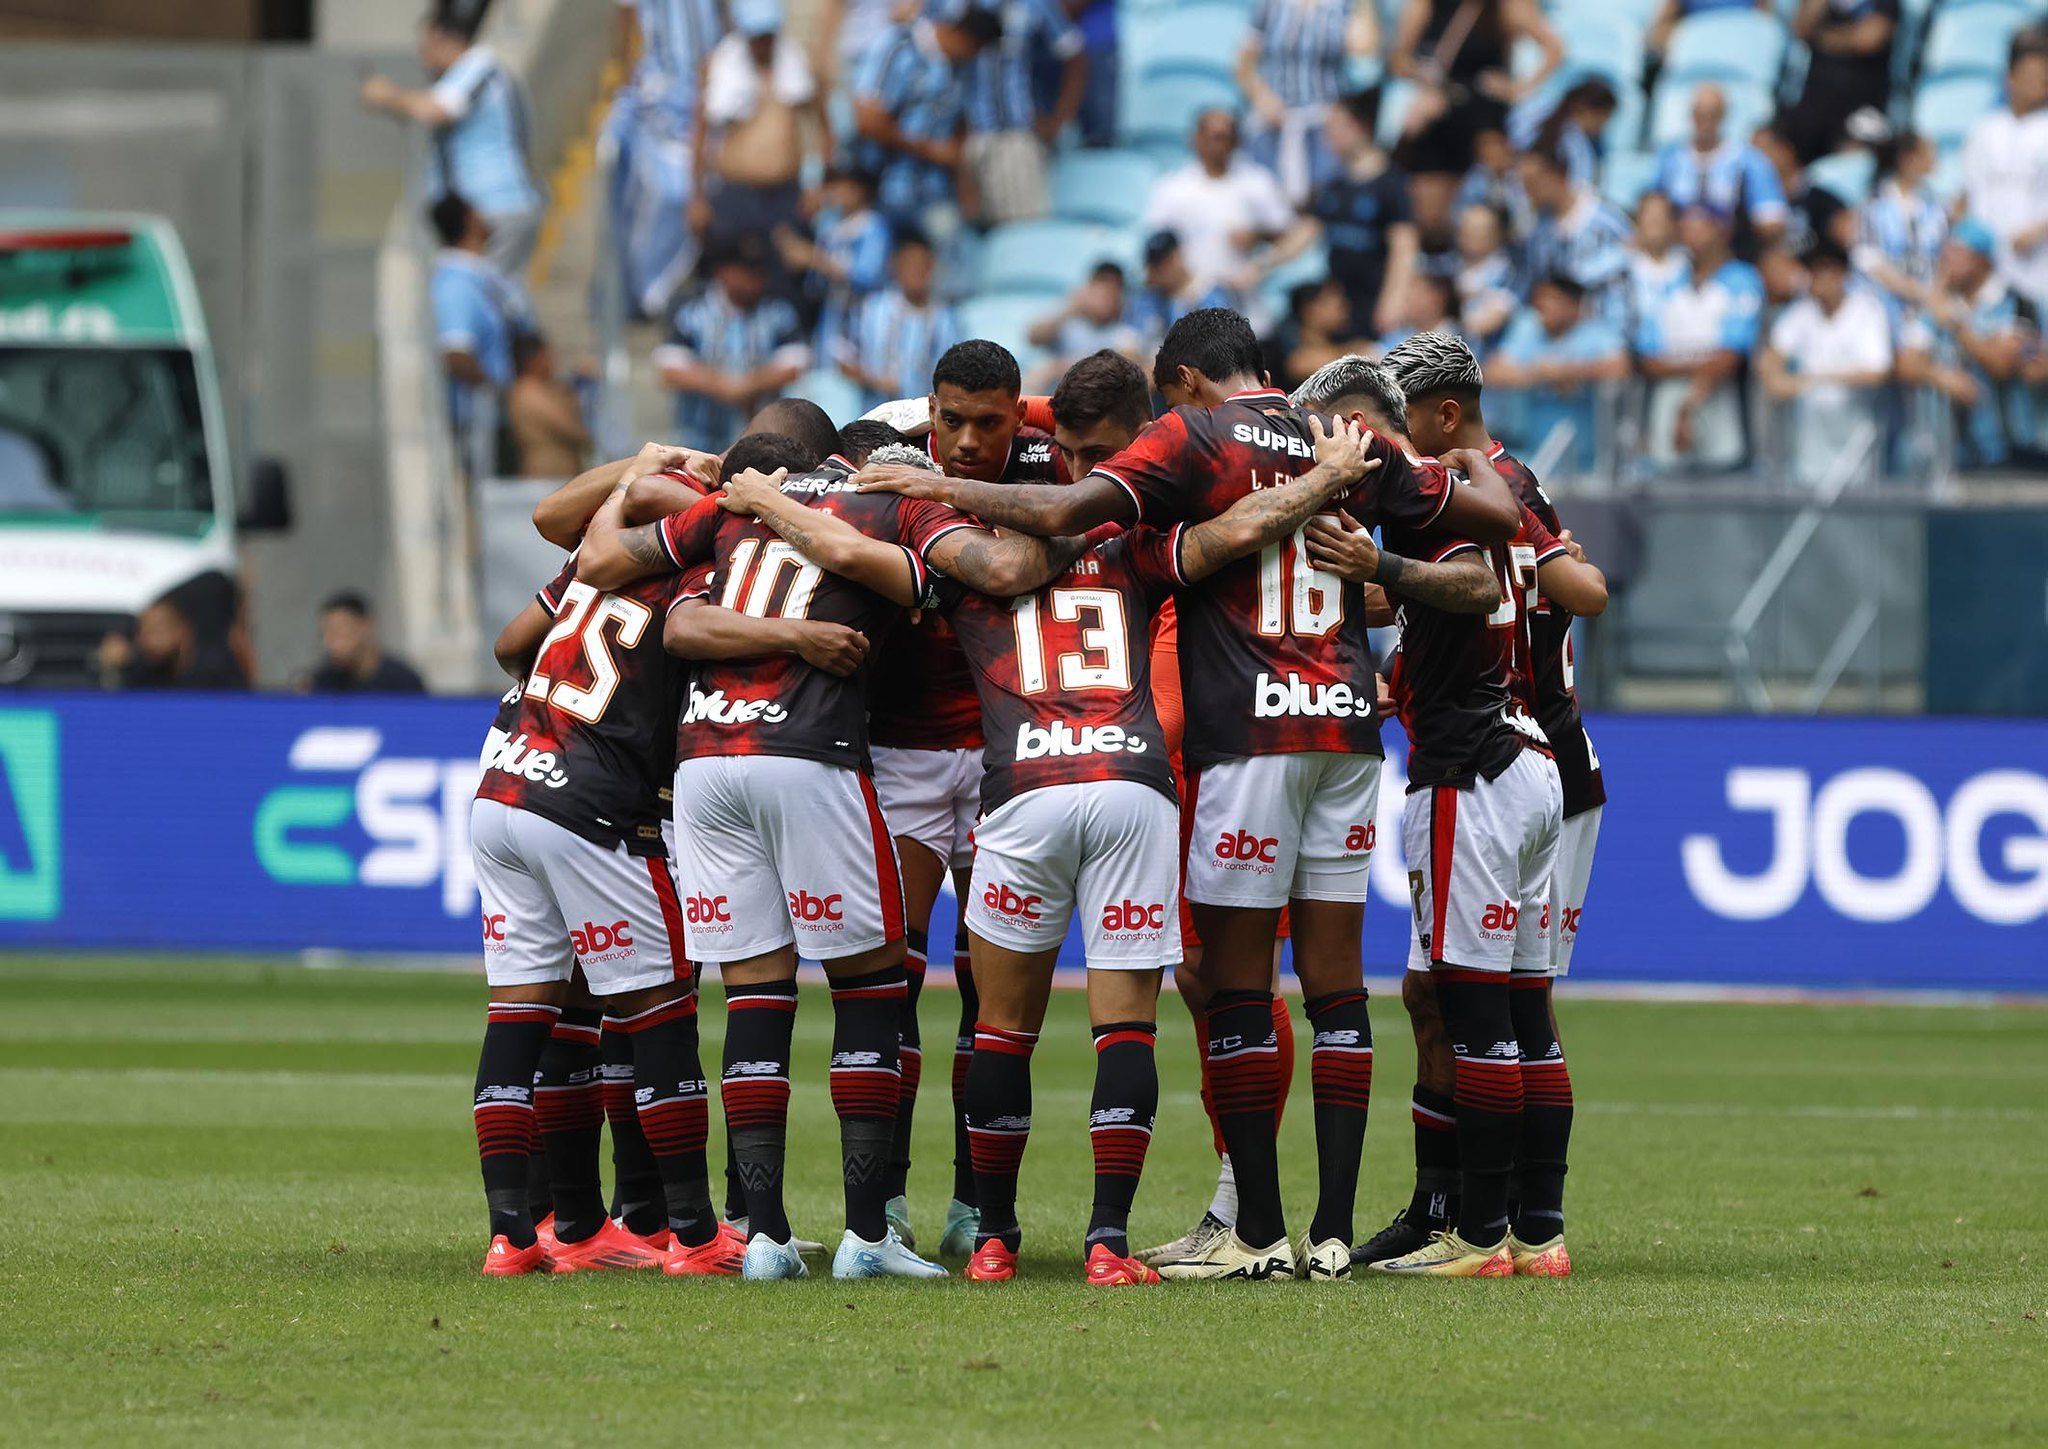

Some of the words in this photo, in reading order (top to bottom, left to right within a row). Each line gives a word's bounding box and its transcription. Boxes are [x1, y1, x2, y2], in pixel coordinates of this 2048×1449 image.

[524, 576, 653, 725] 25
[1010, 586, 1133, 697] 13
[1254, 671, 1354, 719] blue
[1014, 719, 1126, 762] blue
[1215, 829, 1279, 864] abc
[1345, 820, 1377, 851] ab
[1680, 765, 2048, 927] JOG
[1224, 861, 1275, 876] construção
[685, 890, 732, 924] abc
[788, 889, 843, 922] abc
[984, 882, 1043, 920] abc
[1101, 898, 1165, 932] abc
[1481, 899, 1522, 932] ab
[570, 919, 633, 956] abc
